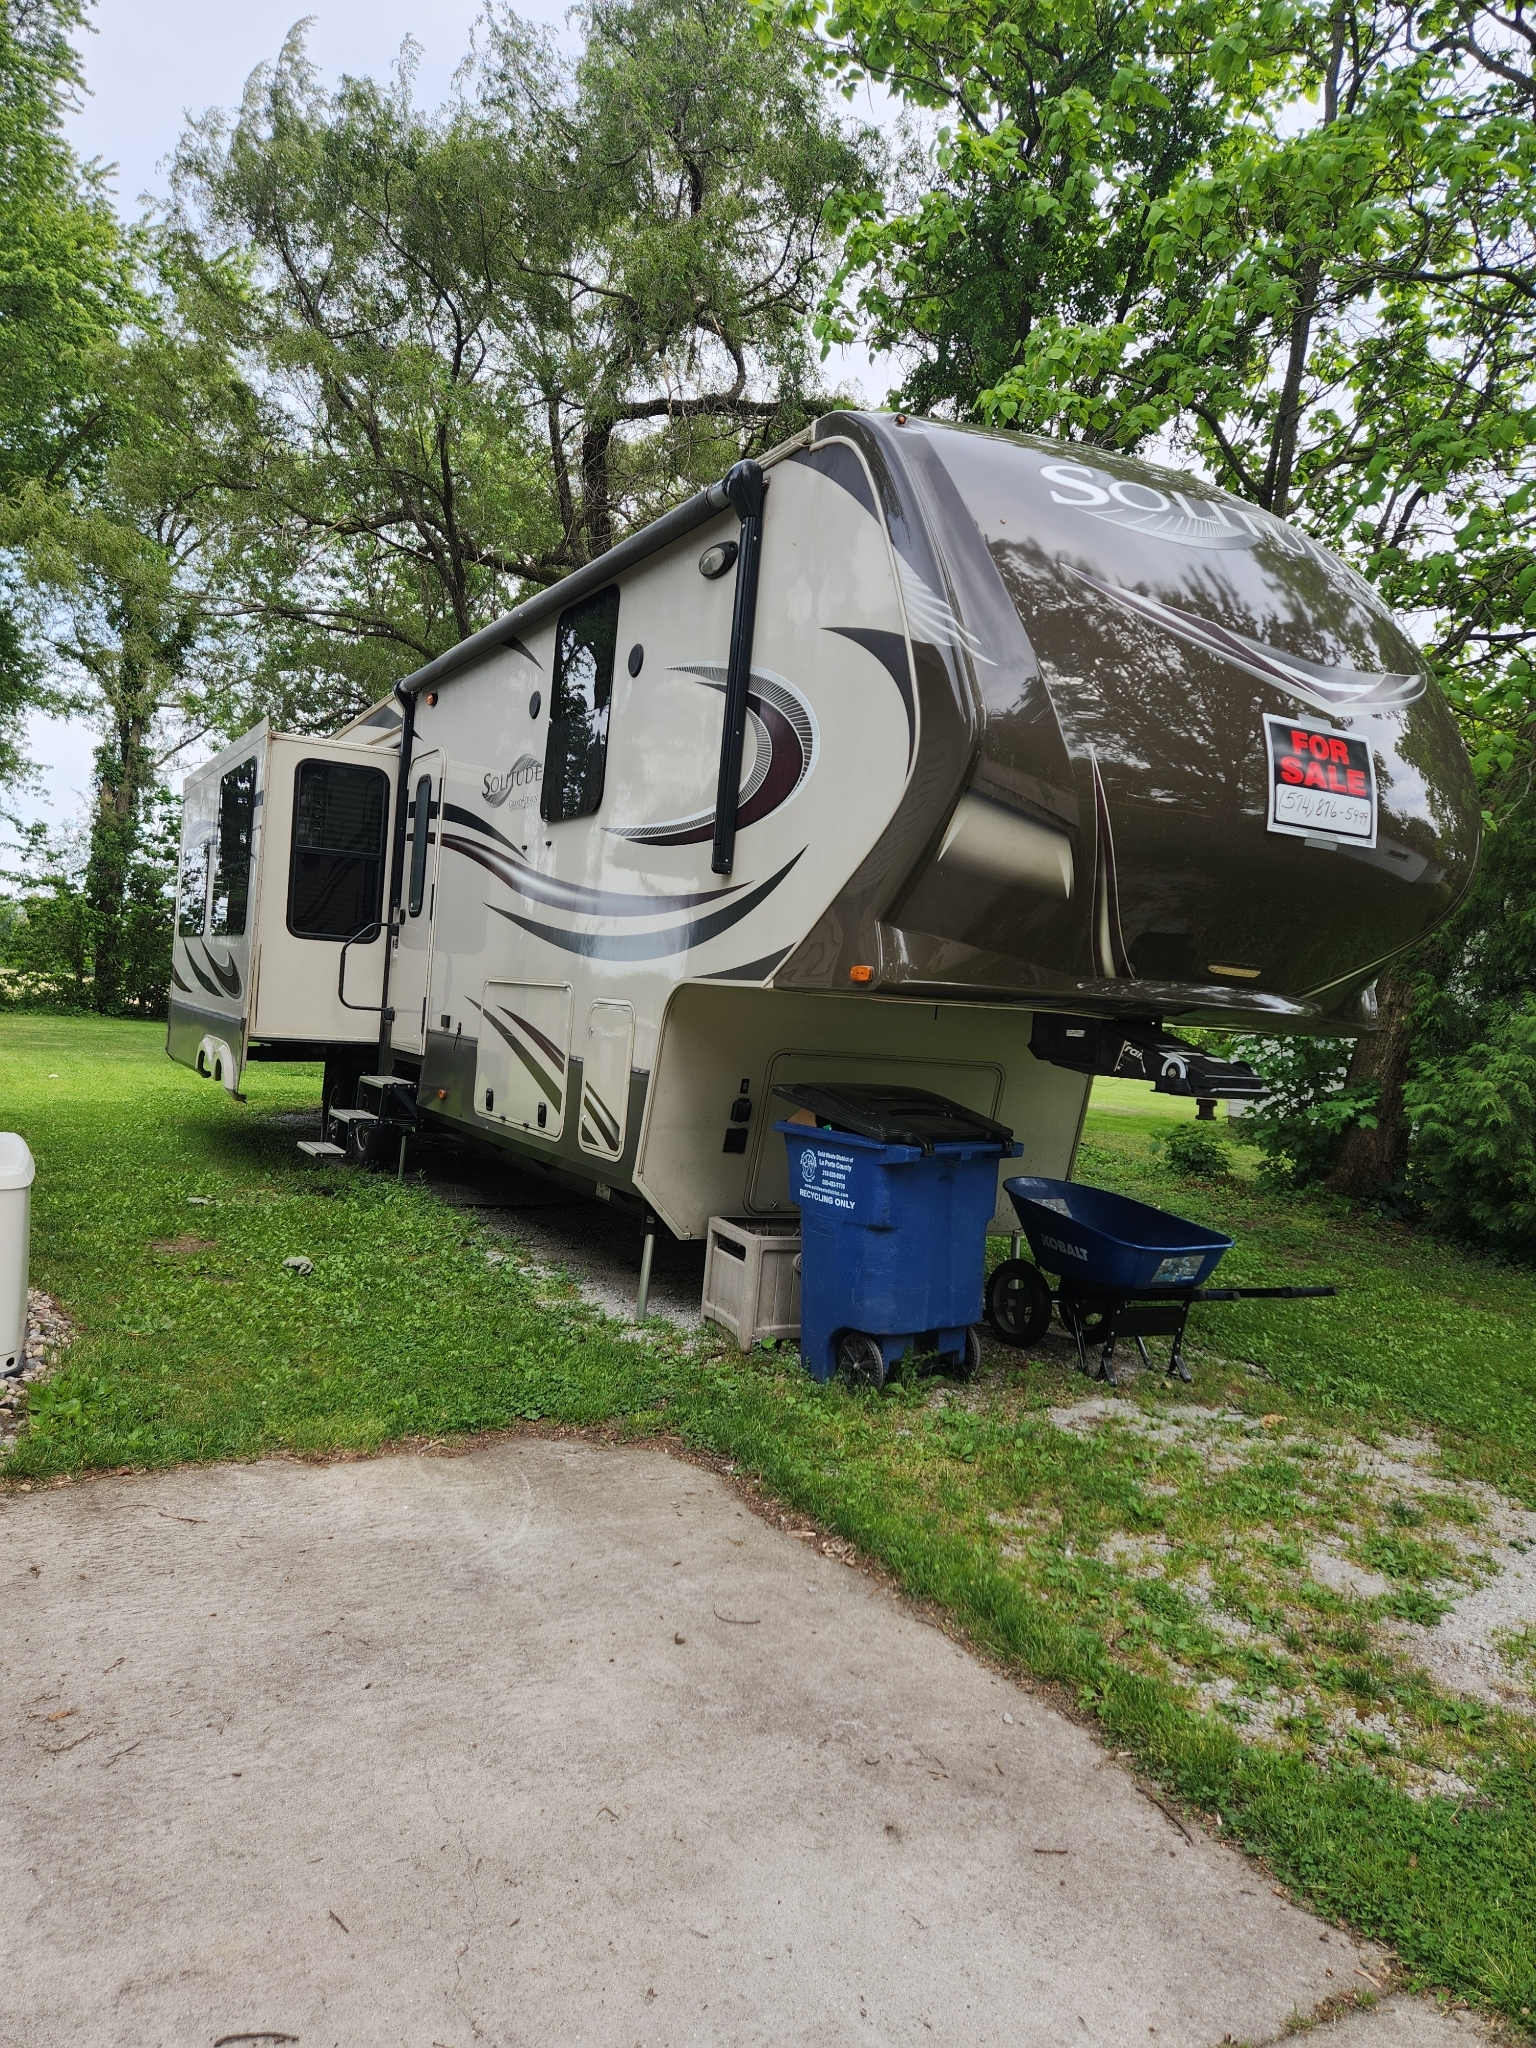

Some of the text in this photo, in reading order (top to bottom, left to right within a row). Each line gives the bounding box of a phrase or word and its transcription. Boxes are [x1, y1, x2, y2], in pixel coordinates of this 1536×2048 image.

[1291, 730, 1350, 765] FOR
[482, 763, 543, 796] SOLITUDE
[1280, 756, 1367, 797] SALE
[819, 1158, 824, 1166] La
[836, 1162, 852, 1173] County
[799, 1188, 856, 1210] RECYCLING ONLY
[1041, 1233, 1088, 1262] KOBALT
